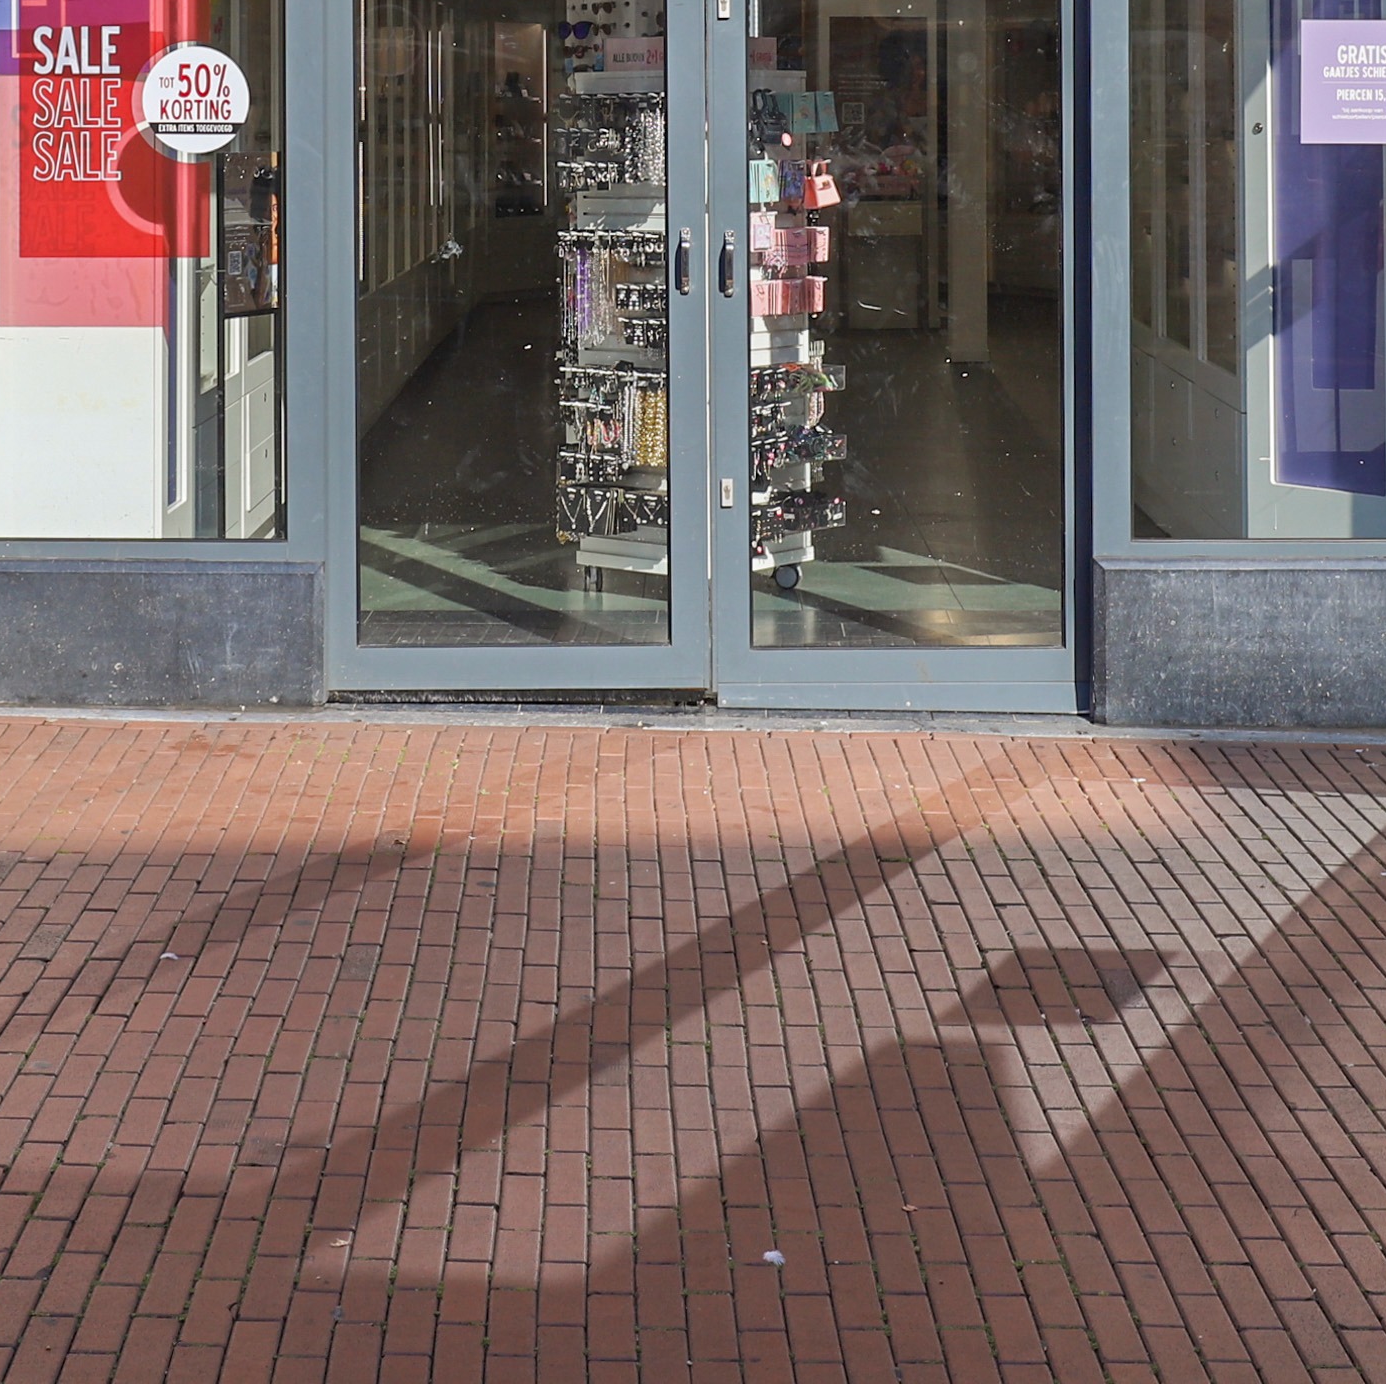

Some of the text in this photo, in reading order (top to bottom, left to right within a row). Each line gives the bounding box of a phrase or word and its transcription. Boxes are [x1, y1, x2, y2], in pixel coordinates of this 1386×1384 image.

[32, 25, 121, 75] SALE
[159, 63, 230, 98] TOT 50%
[1323, 66, 1360, 78] GAATJES
[32, 78, 122, 128] SALE
[1336, 89, 1373, 101] PIERCEN
[160, 99, 232, 120] KORTING
[158, 124, 233, 133] EXTRA ITEMS TOEGEVOEGD
[32, 131, 122, 181] SALE
